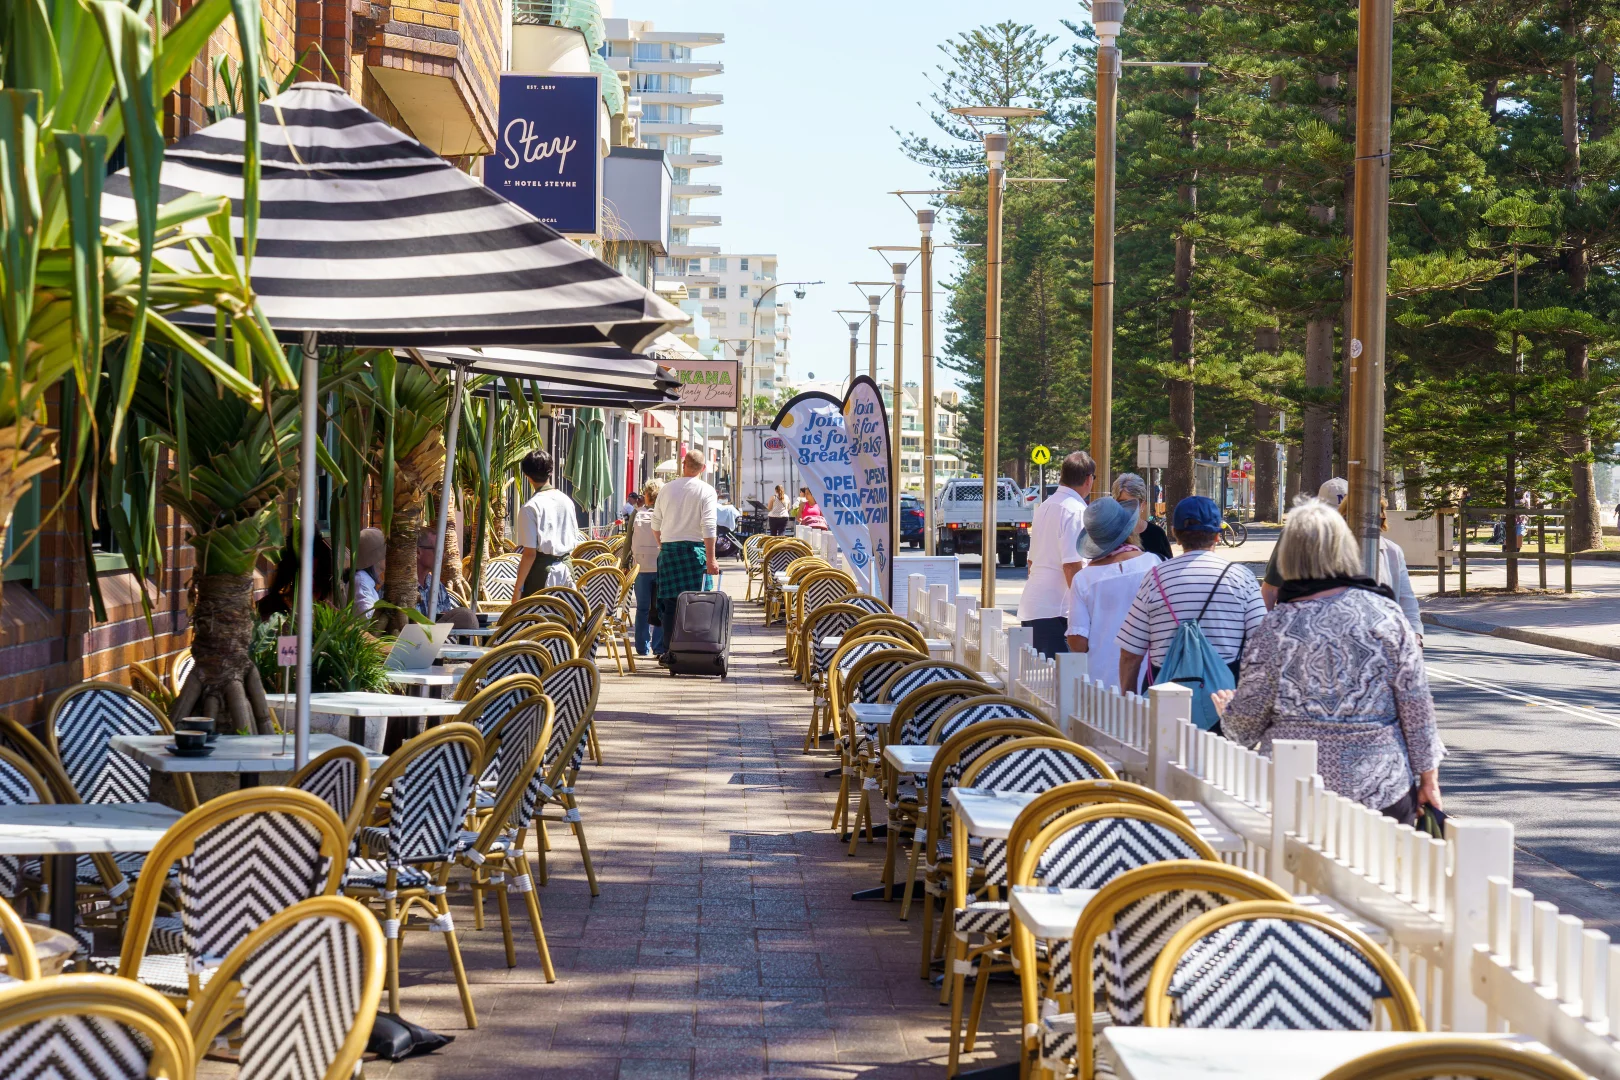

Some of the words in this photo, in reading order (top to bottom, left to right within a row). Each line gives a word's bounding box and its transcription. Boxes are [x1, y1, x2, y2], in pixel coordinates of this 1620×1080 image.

[504, 118, 577, 175] Stay
[704, 384, 735, 401] Beach
[804, 412, 844, 431] Join
[801, 430, 822, 445] us
[798, 447, 852, 466] Break
[834, 510, 867, 525] 7AM
[865, 506, 889, 524] 7AM
